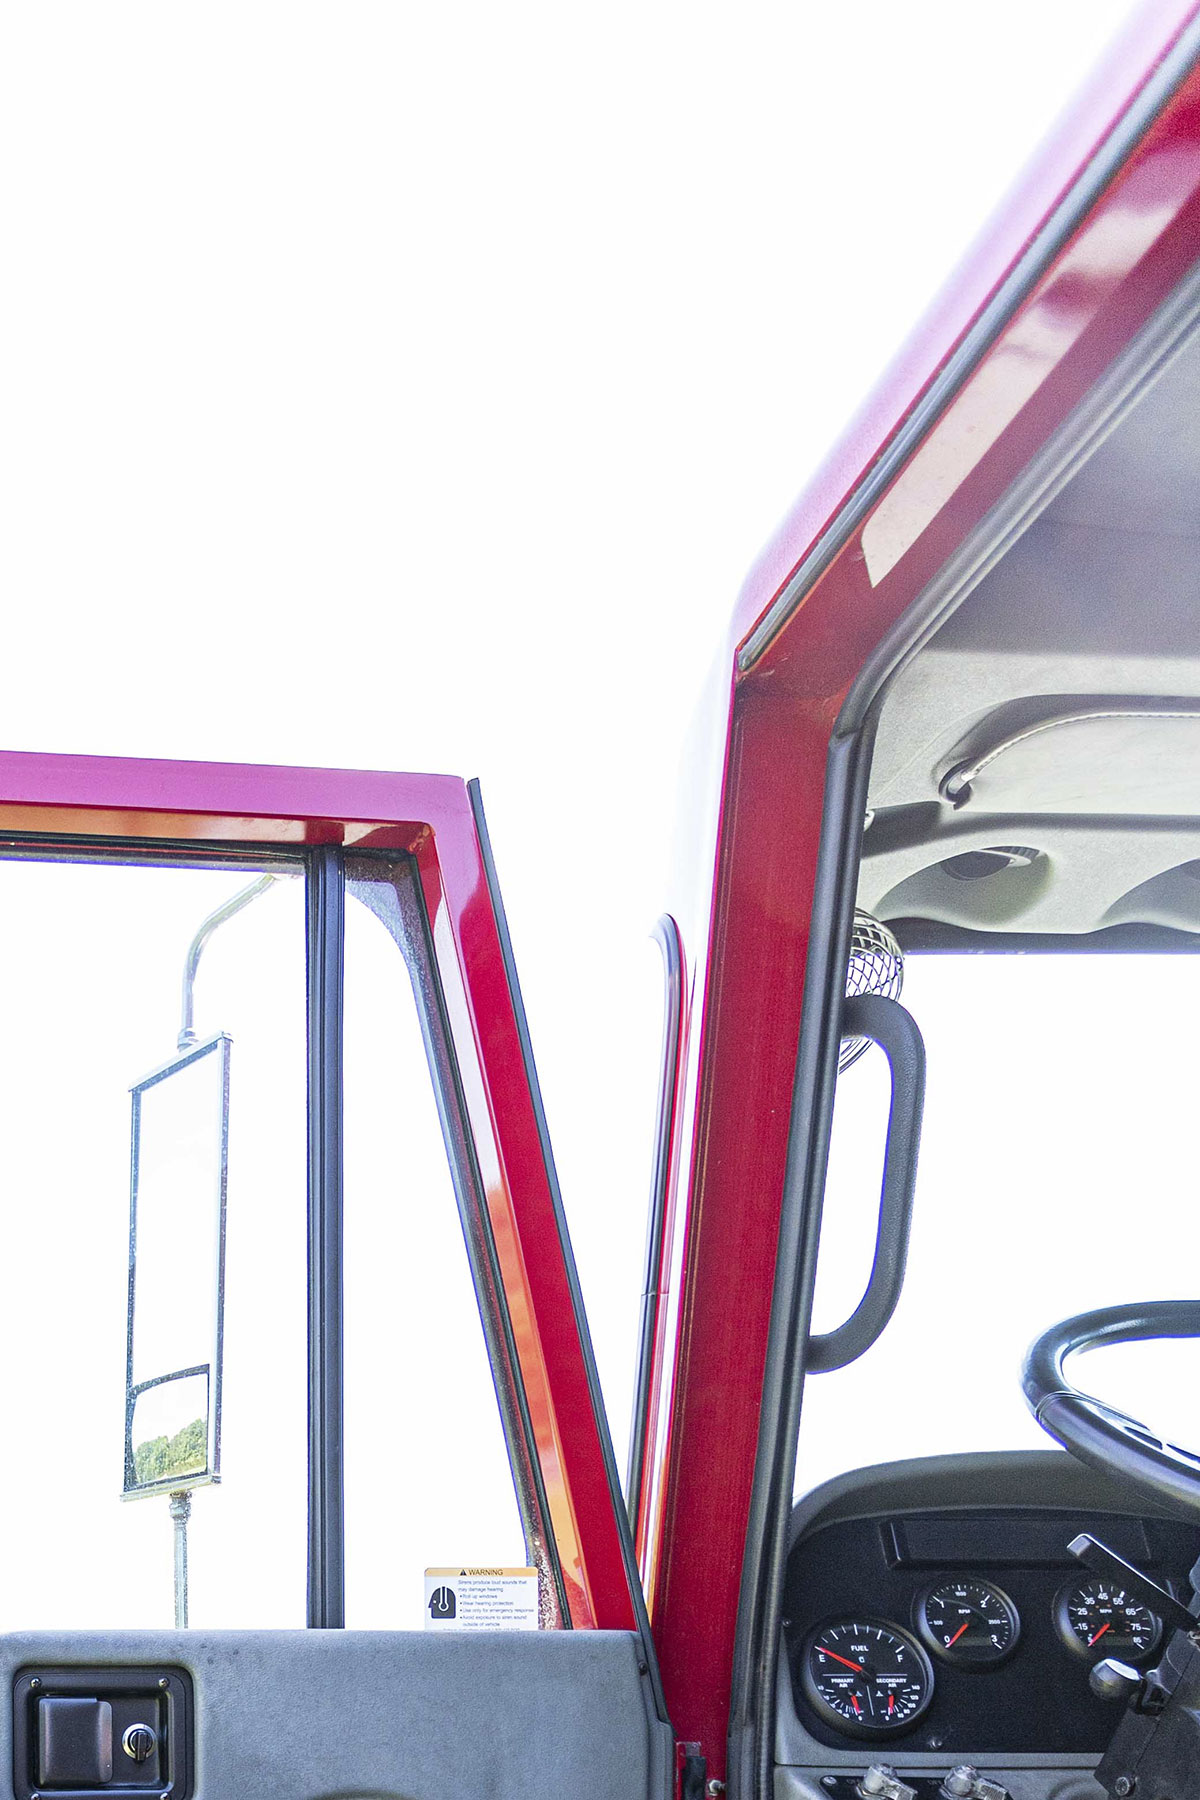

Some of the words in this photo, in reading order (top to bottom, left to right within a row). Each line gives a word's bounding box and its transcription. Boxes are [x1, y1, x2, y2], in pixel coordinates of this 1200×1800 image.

[980, 1600, 987, 1608] 2
[1125, 1608, 1136, 1616] 65
[1130, 1623, 1141, 1631] 75
[944, 1635, 950, 1643] 0
[819, 1654, 826, 1662] E
